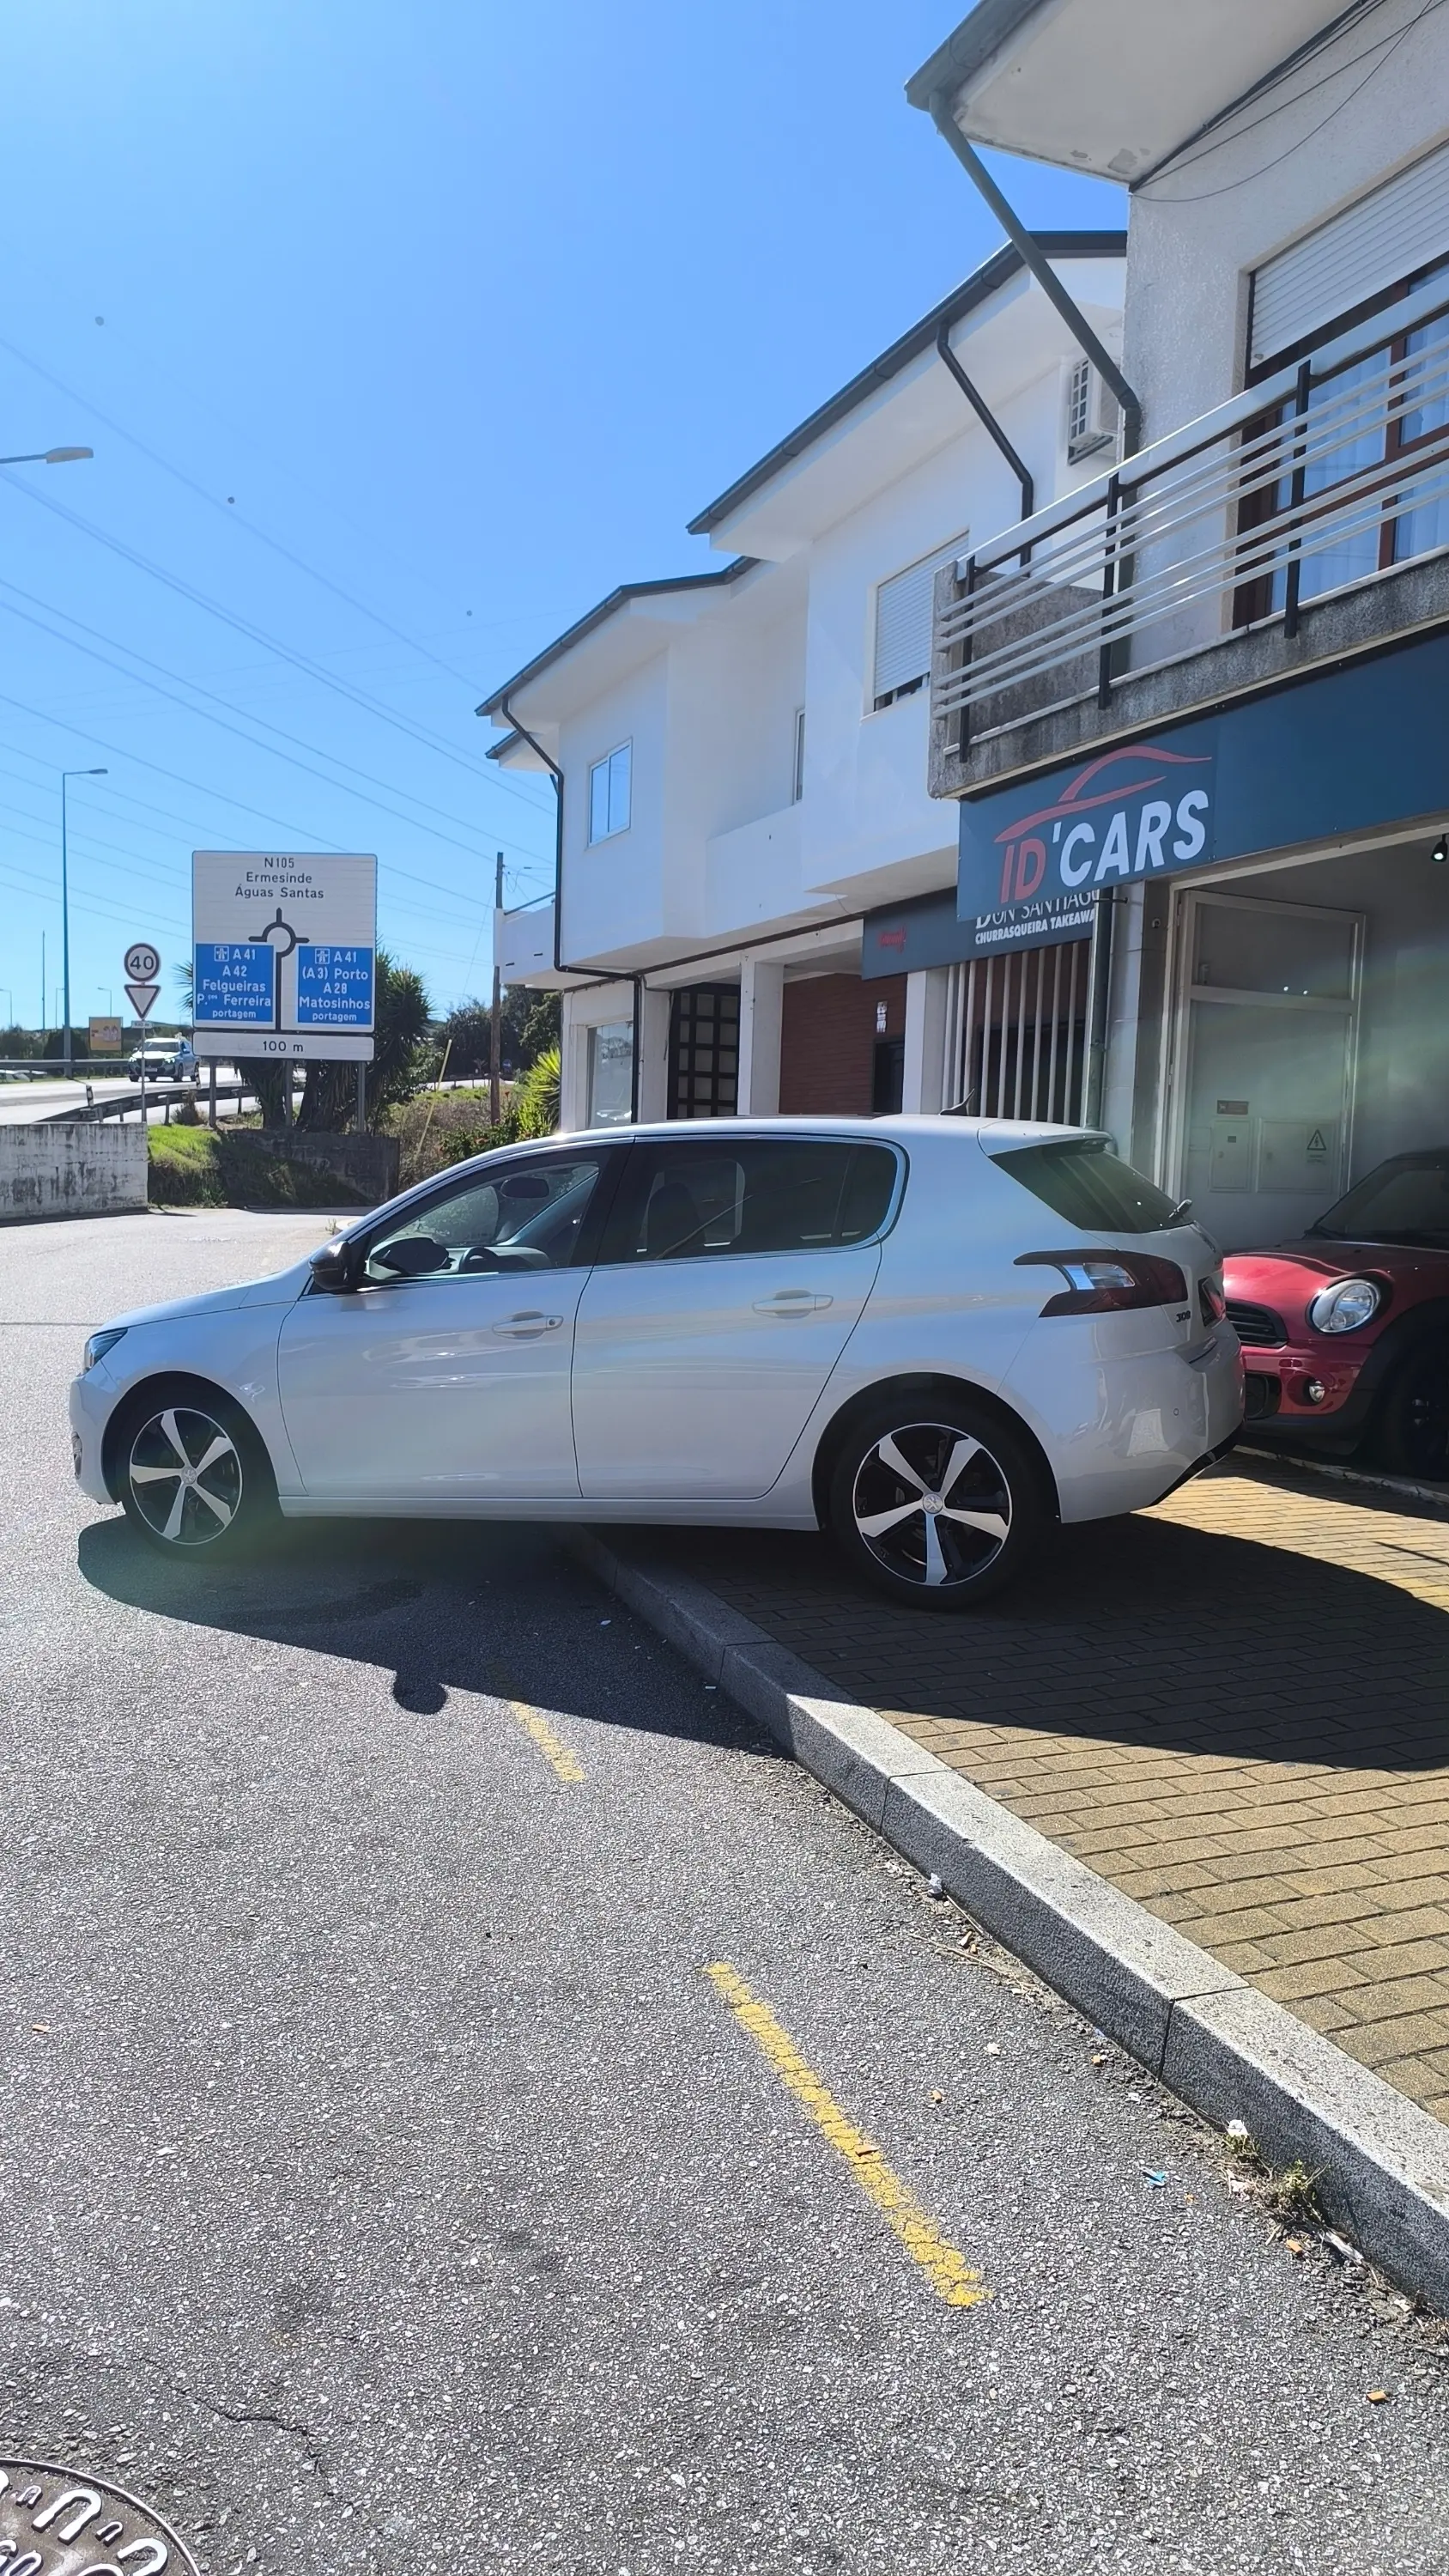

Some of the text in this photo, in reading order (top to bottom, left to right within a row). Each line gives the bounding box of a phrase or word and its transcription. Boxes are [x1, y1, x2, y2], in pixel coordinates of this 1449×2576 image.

[264, 857, 294, 868] N105
[246, 872, 312, 884] Ermesinde
[235, 884, 324, 899] Águas Santas
[975, 919, 1048, 945] CHURRASQUEIRA
[130, 956, 155, 970] 40
[334, 968, 368, 981] Porto
[203, 979, 266, 993] Felgueiras
[223, 994, 271, 1006] Ferreira
[299, 996, 371, 1010] Matosinhos
[212, 1009, 257, 1019] portagem
[312, 1012, 357, 1023] portagem
[263, 1040, 287, 1052] 100
[1176, 1309, 1191, 1322] 308
